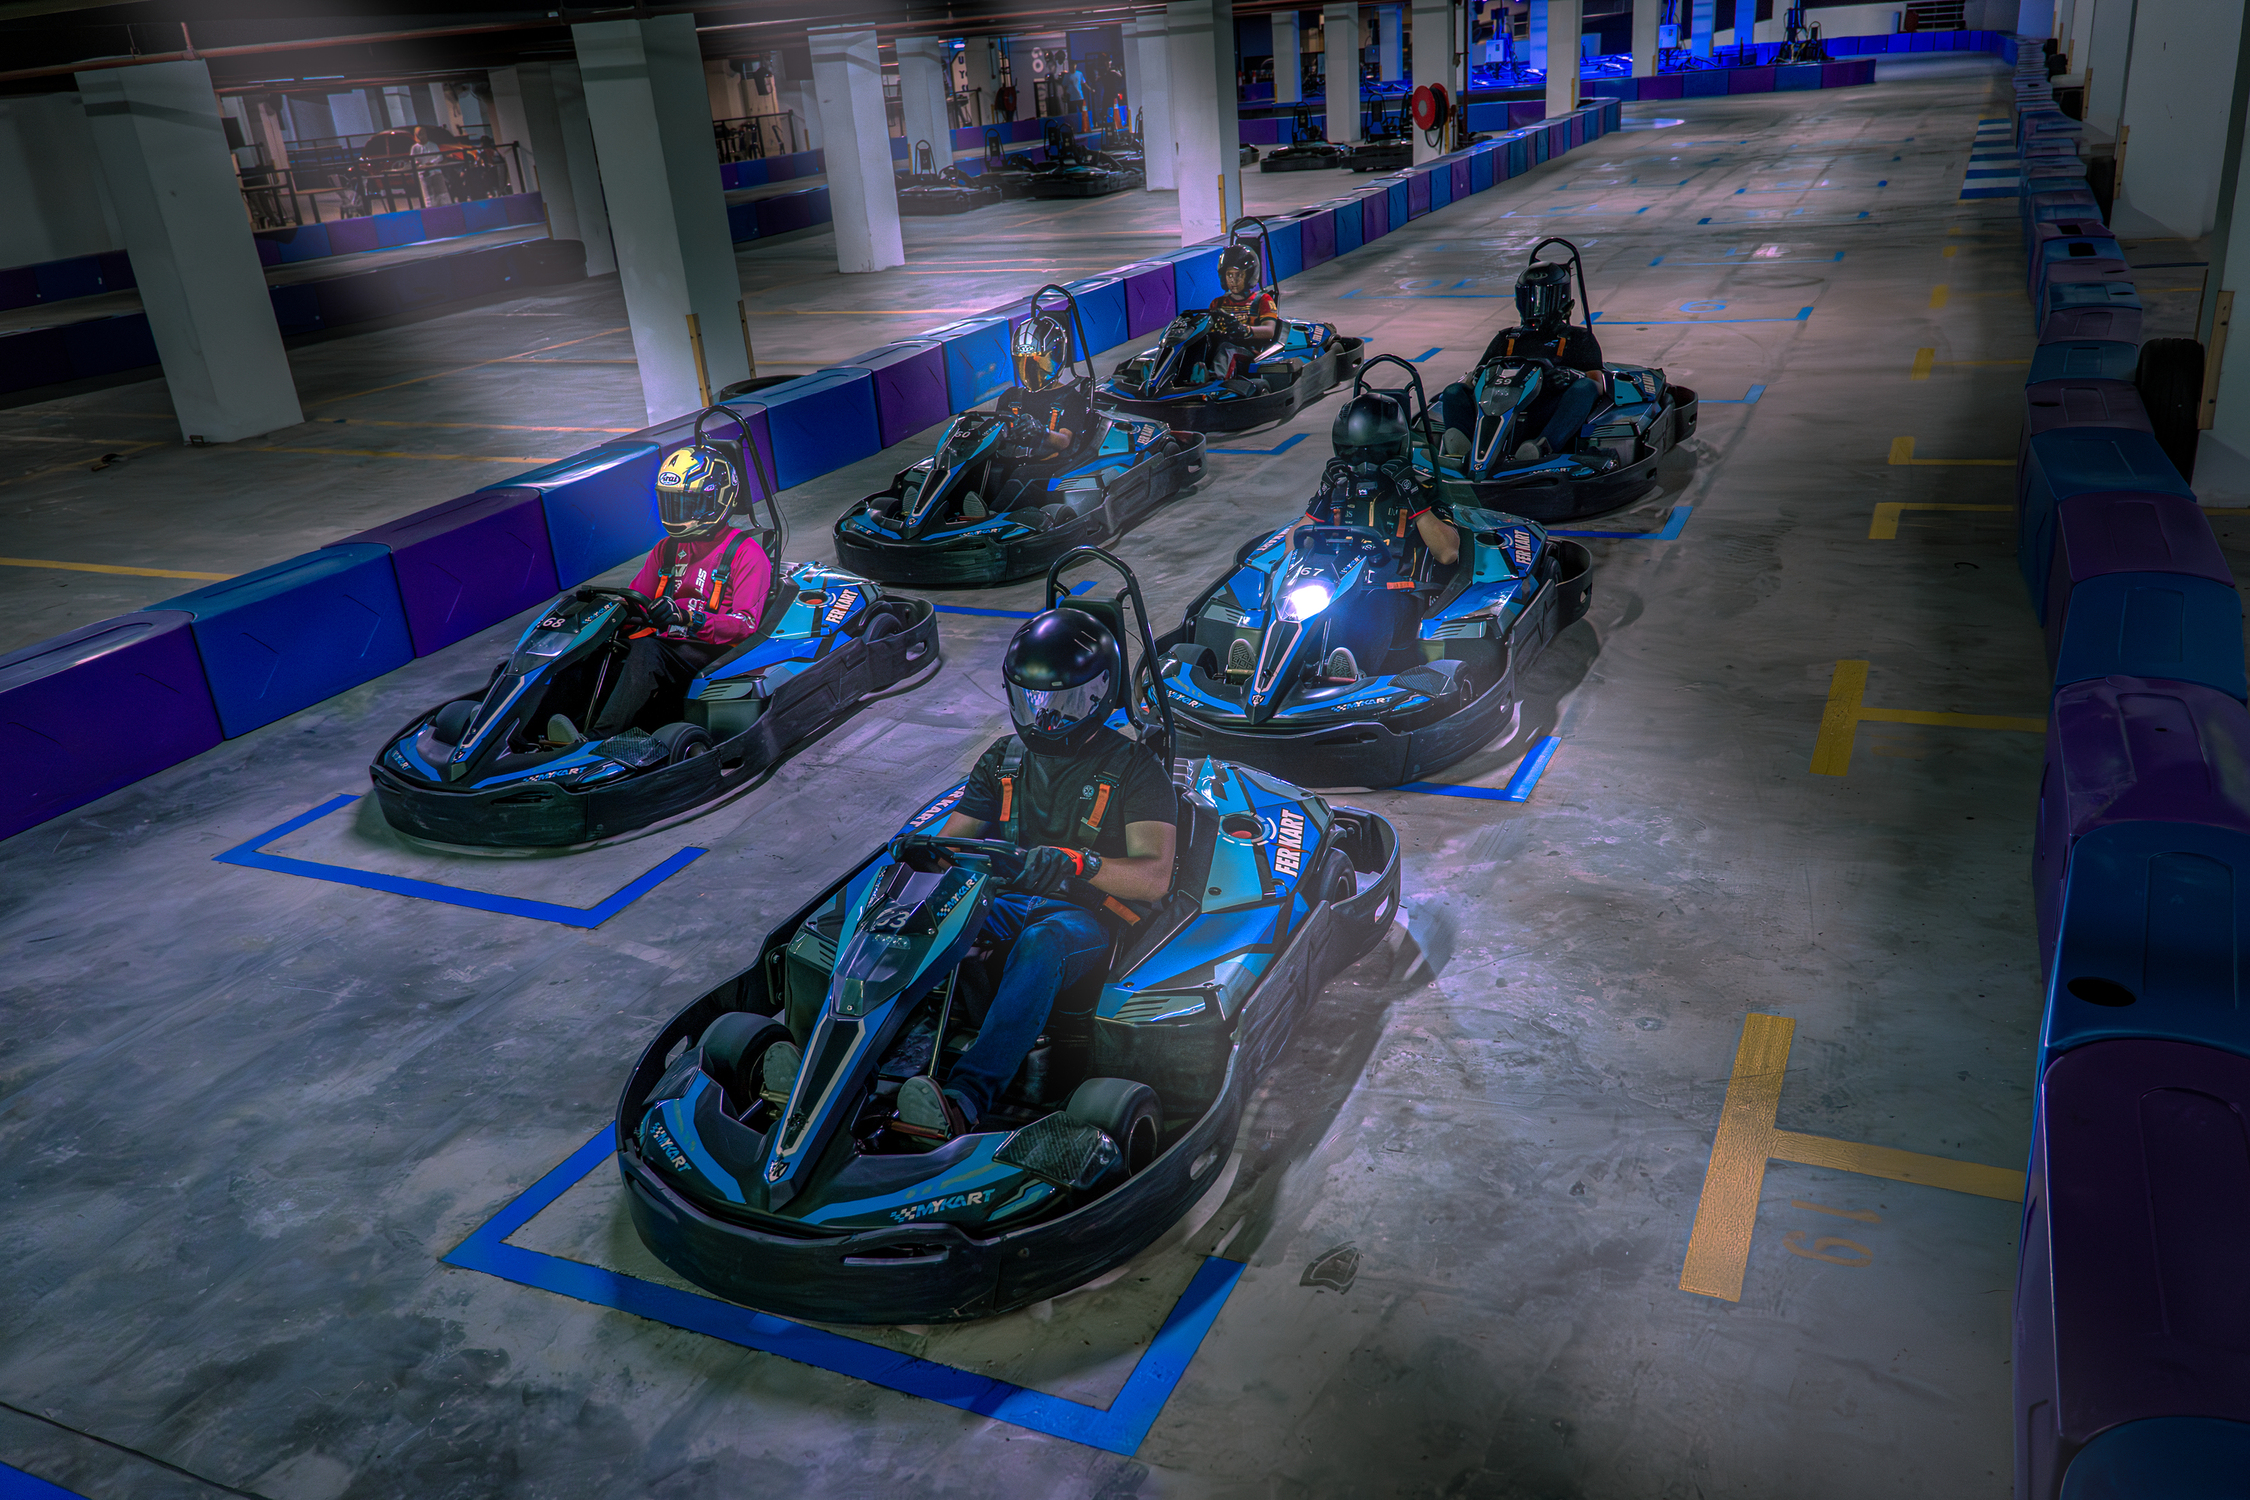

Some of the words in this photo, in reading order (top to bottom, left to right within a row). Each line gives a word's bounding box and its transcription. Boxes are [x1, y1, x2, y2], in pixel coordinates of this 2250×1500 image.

[1494, 377, 1512, 386] 59
[1300, 567, 1324, 577] 67
[542, 617, 566, 628] 68
[946, 873, 978, 909] MYKART
[655, 1131, 693, 1172] MYKART
[915, 1188, 996, 1218] MYKART
